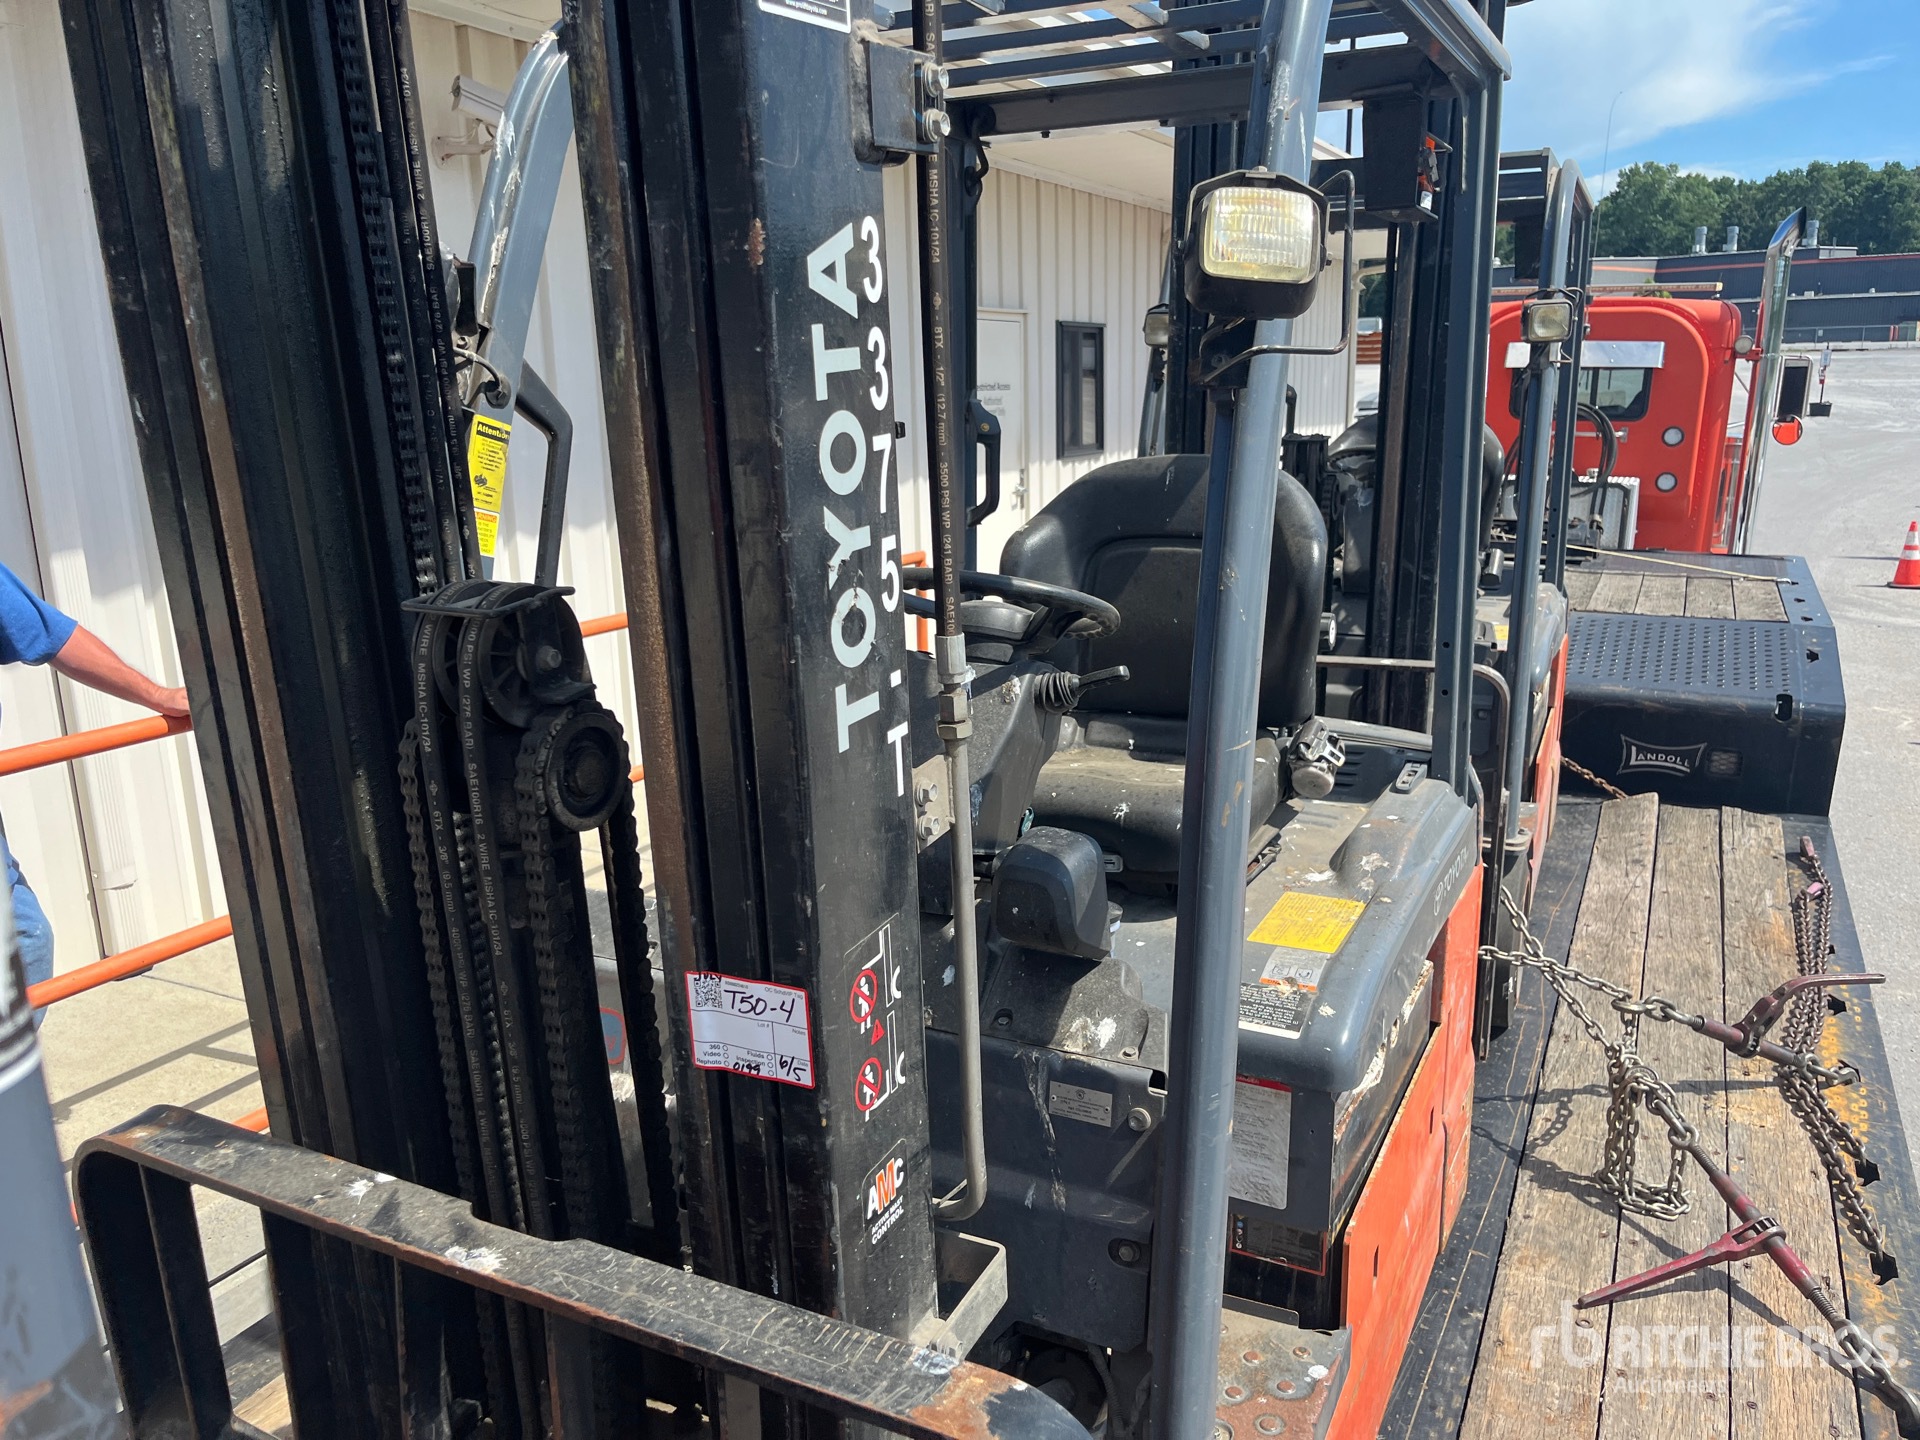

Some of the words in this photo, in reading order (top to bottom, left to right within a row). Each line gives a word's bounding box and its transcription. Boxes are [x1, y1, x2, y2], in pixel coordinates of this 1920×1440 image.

[412, 160, 423, 190] WIRE
[928, 169, 938, 205] MSHA
[929, 209, 940, 263] IC-101/34
[436, 337, 445, 355] WP
[934, 326, 943, 348] 8TX
[438, 357, 448, 374] PSI
[935, 393, 946, 419] (12.7
[936, 422, 946, 446] mm)
[939, 461, 948, 487] 3500
[807, 223, 880, 754] TOYOTA
[940, 490, 949, 508] PSI
[941, 510, 950, 528] WP
[942, 534, 951, 554] (241
[943, 558, 953, 584] BAR)
[420, 624, 433, 656] WIRE
[462, 644, 473, 664] PSI
[416, 662, 427, 698] MSHA
[461, 668, 471, 688] WP
[418, 701, 432, 752] IC-101/34
[461, 720, 474, 749] BAR)
[1630, 745, 1690, 770] LANDOLL
[466, 762, 485, 825] SAE100R16
[432, 810, 443, 830] 6TX
[476, 832, 485, 840] 2
[437, 845, 448, 865] 3/8"
[478, 842, 490, 870] WIRE
[441, 870, 452, 888] (9.5
[483, 875, 495, 907] MSHA
[444, 890, 455, 913] mm)
[450, 926, 461, 950] 4000
[489, 909, 502, 956] IC-101/34
[457, 970, 467, 987] WP
[724, 990, 795, 1023] T50-4
[463, 1013, 475, 1039] BAR)
[867, 1158, 904, 1220] AMC
[872, 1211, 890, 1234] ACTIVE
[890, 1195, 903, 1214] MAST
[872, 1206, 904, 1245] CONTROL
